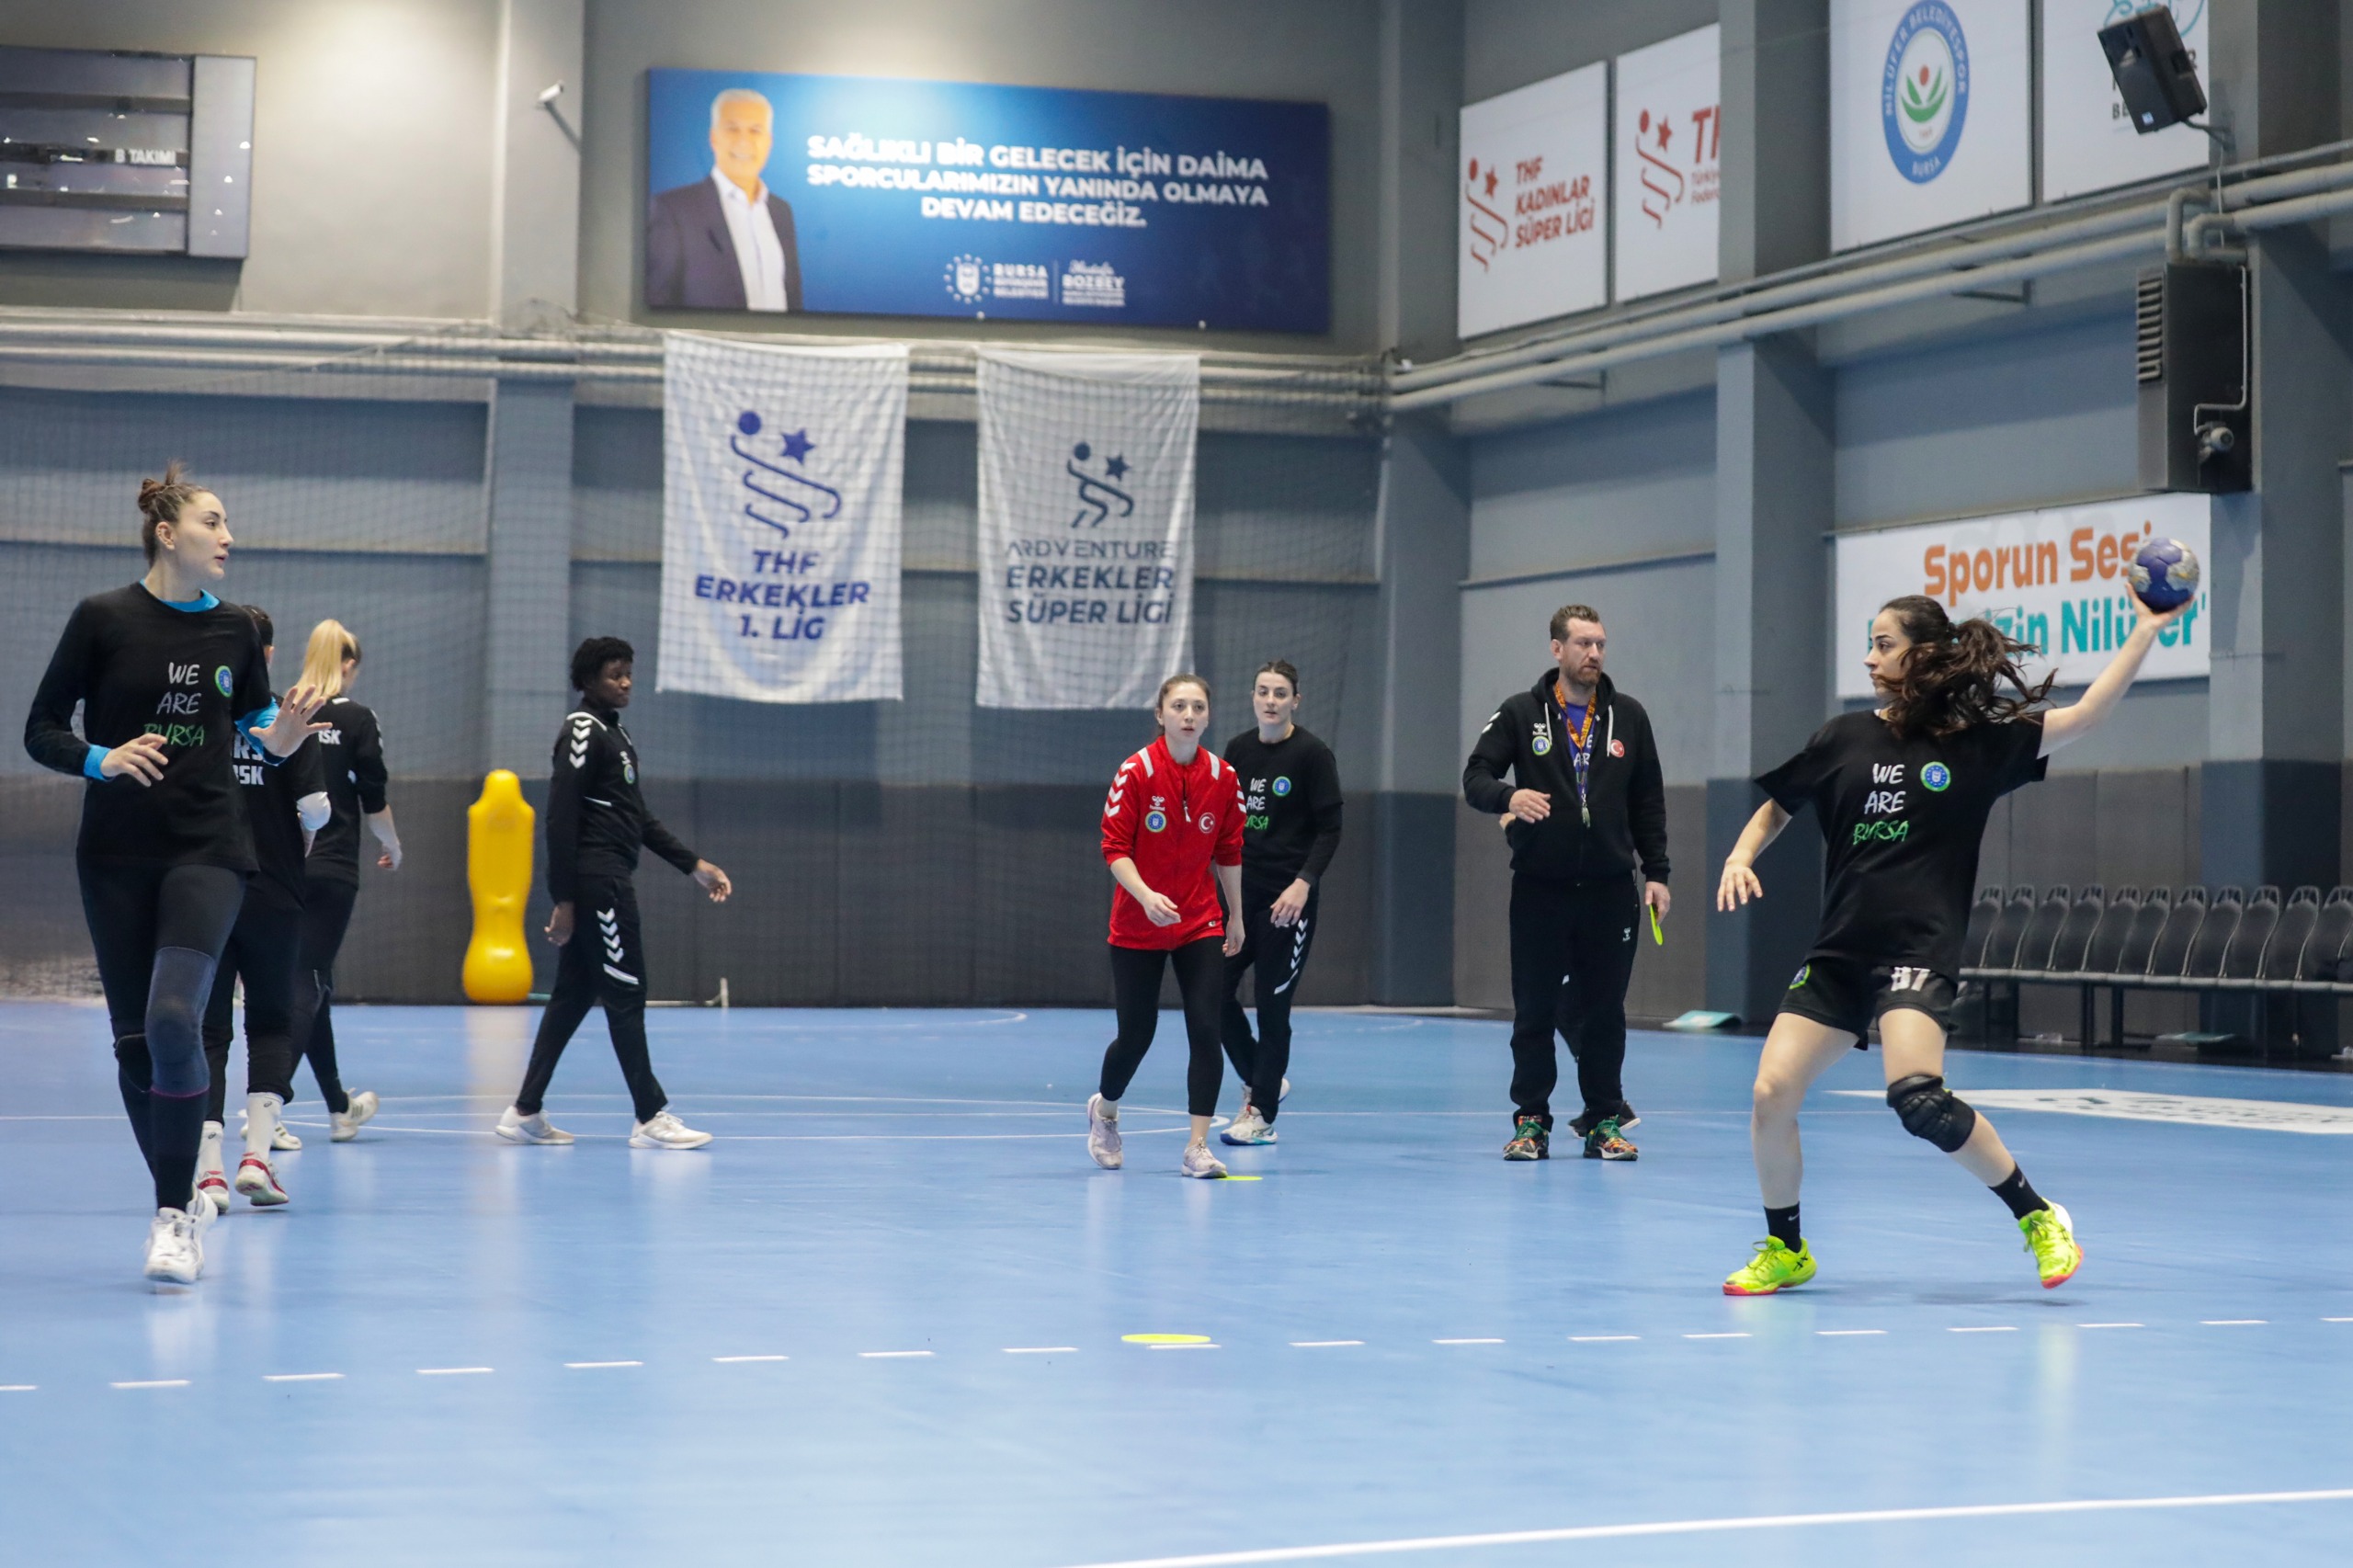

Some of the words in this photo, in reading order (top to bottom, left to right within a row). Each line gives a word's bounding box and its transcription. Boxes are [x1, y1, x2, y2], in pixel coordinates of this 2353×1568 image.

[115, 148, 126, 164] B
[129, 148, 176, 165] TAKIMI
[807, 132, 931, 164] SAĞLIKLI
[937, 137, 984, 167] BİR
[989, 145, 1111, 173] GELECEK
[1116, 145, 1171, 179] İÇİN
[1177, 150, 1269, 180] DAİMA
[1516, 155, 1542, 185] THF
[806, 164, 1039, 196] SPORCULARIMIZIN
[1044, 176, 1158, 201] YANINDA
[1163, 182, 1269, 207] OLMAYA
[1515, 175, 1590, 216] KADINLAR
[921, 196, 1014, 221] DEVAM
[1019, 200, 1147, 228] EDECEĞİZ.
[1515, 214, 1562, 248] SÜPER
[1566, 197, 1596, 235] LİGİ
[993, 263, 1049, 278] BURSA
[753, 549, 820, 574] THF
[1924, 540, 2058, 608] Sporun
[2070, 520, 2152, 582] Ses
[1006, 565, 1174, 589] ERKEKLER
[694, 574, 870, 608] ERKEKLER
[1006, 592, 1108, 624] SÜPER
[1117, 592, 1175, 624] LİGİ
[741, 613, 759, 638] 1.
[771, 607, 824, 640] LİG
[168, 662, 200, 686] WE
[156, 691, 201, 715] ARE
[1250, 778, 1267, 792] WE
[1872, 763, 1905, 785] WE
[1246, 795, 1266, 811] ARE
[1864, 790, 1906, 815] ARE
[1853, 820, 1909, 846] BURSA
